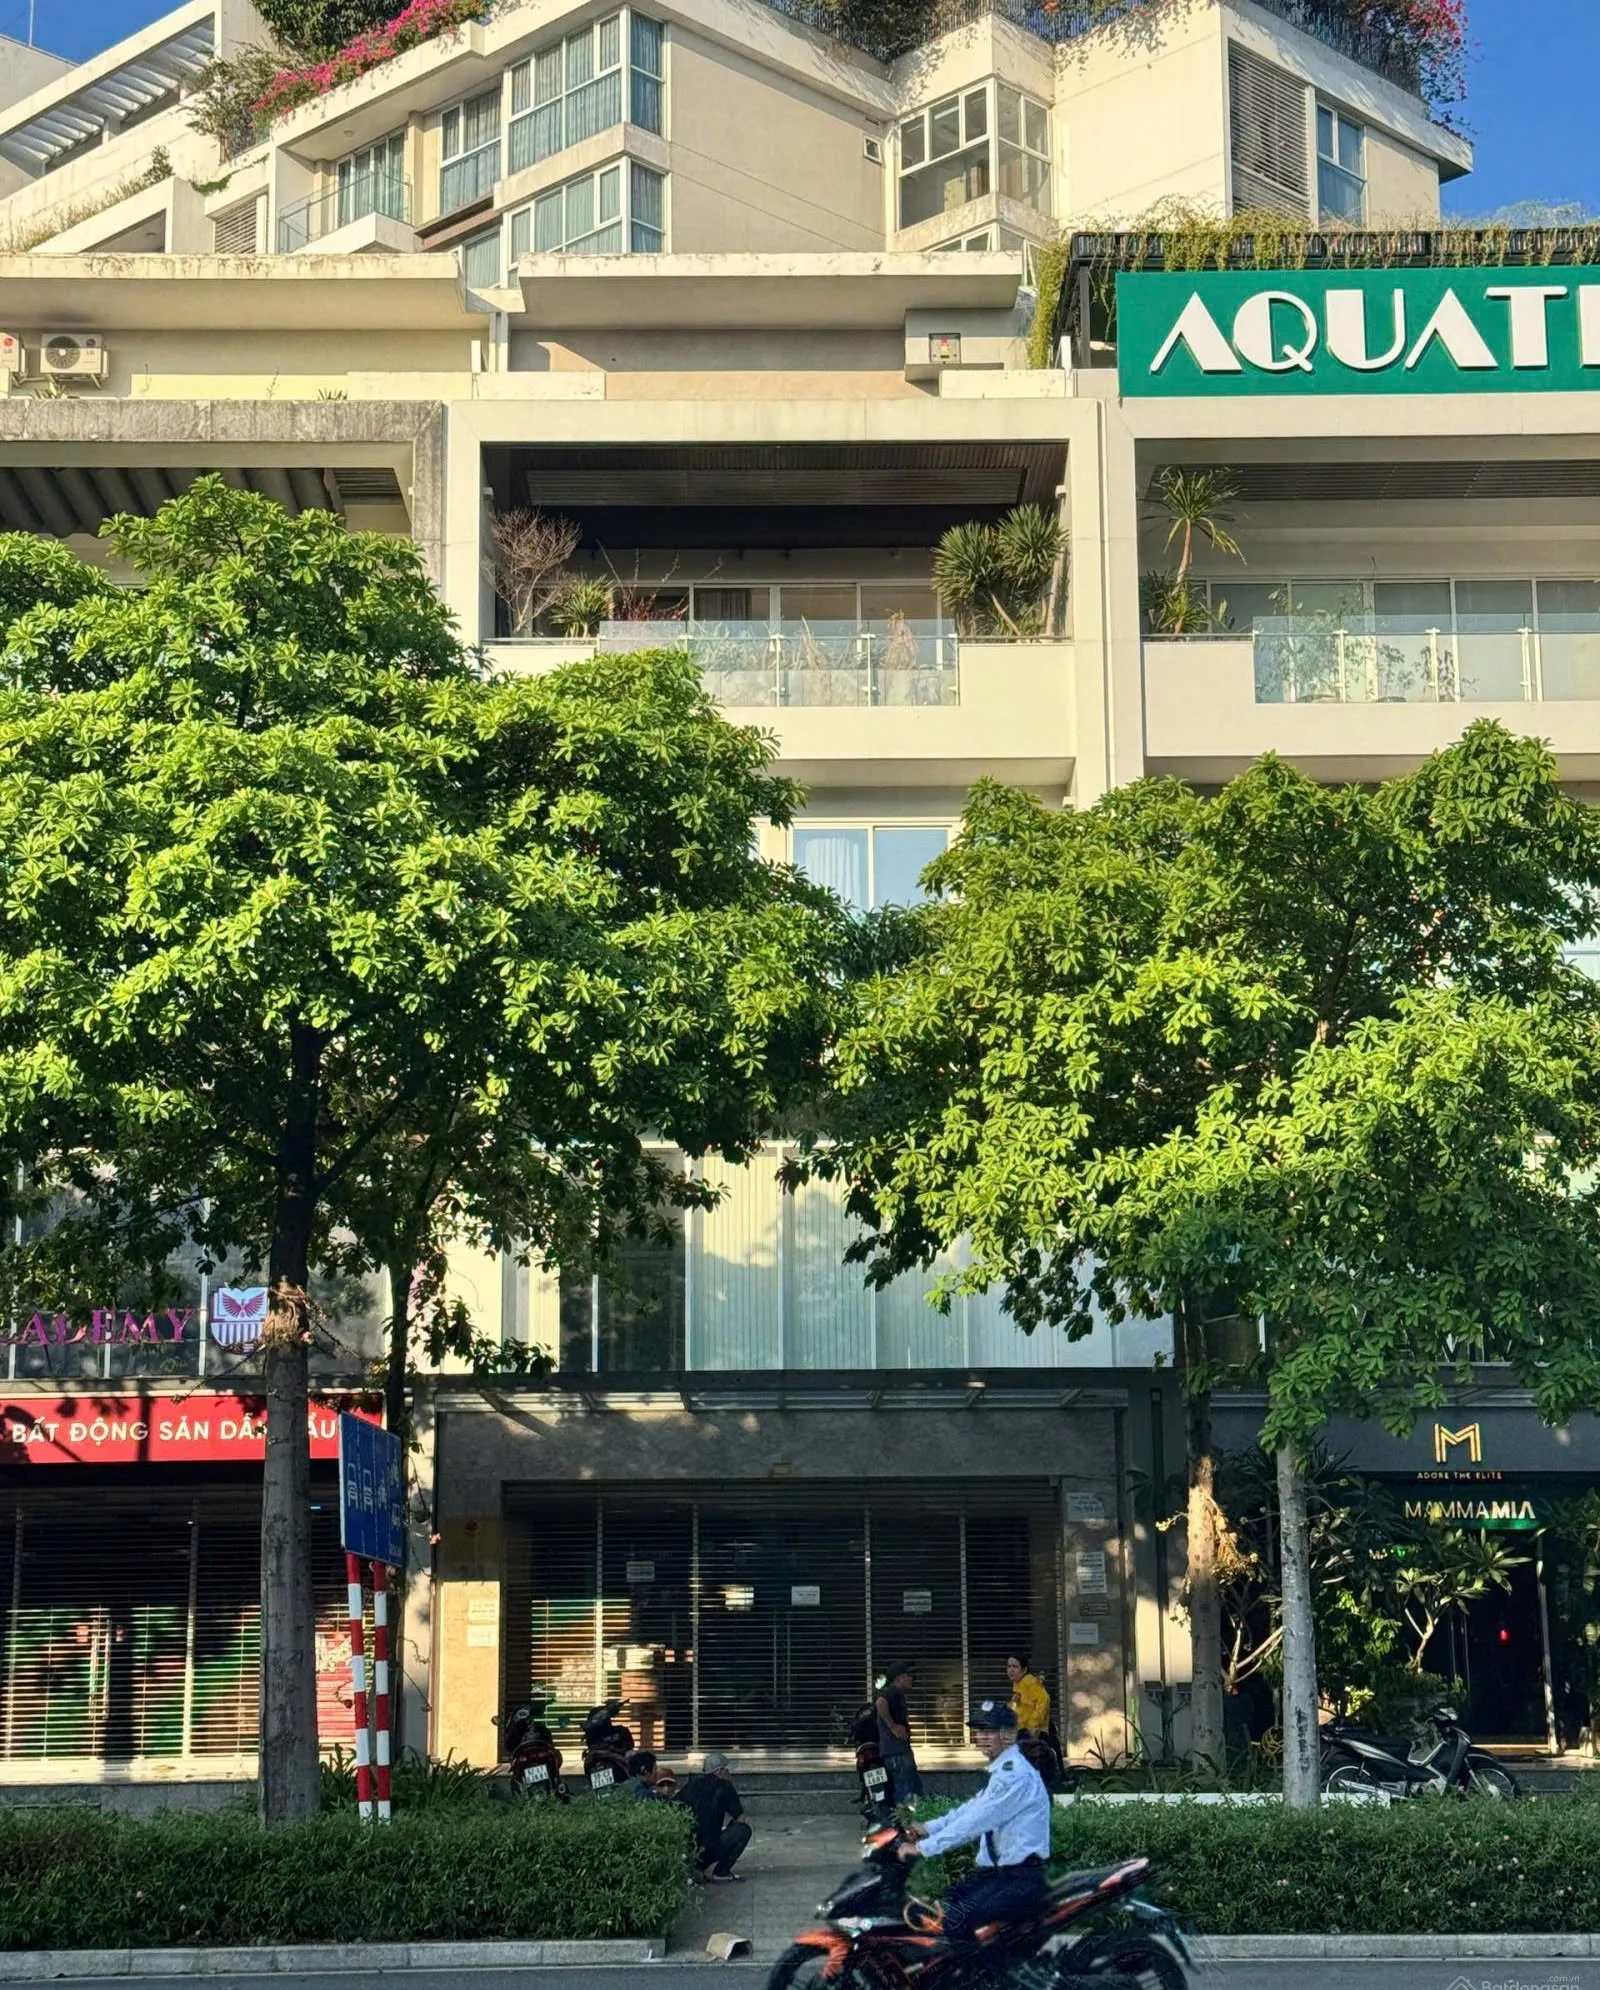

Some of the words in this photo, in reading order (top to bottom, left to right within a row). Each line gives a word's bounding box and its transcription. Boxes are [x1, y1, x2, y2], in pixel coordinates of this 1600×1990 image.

[12, 1417, 60, 1443] BẤT
[69, 1416, 149, 1446] ĐỘNG
[159, 1415, 209, 1441] SẢN
[1417, 1472, 1449, 1480] ADORE
[1476, 1472, 1502, 1480] ELITE
